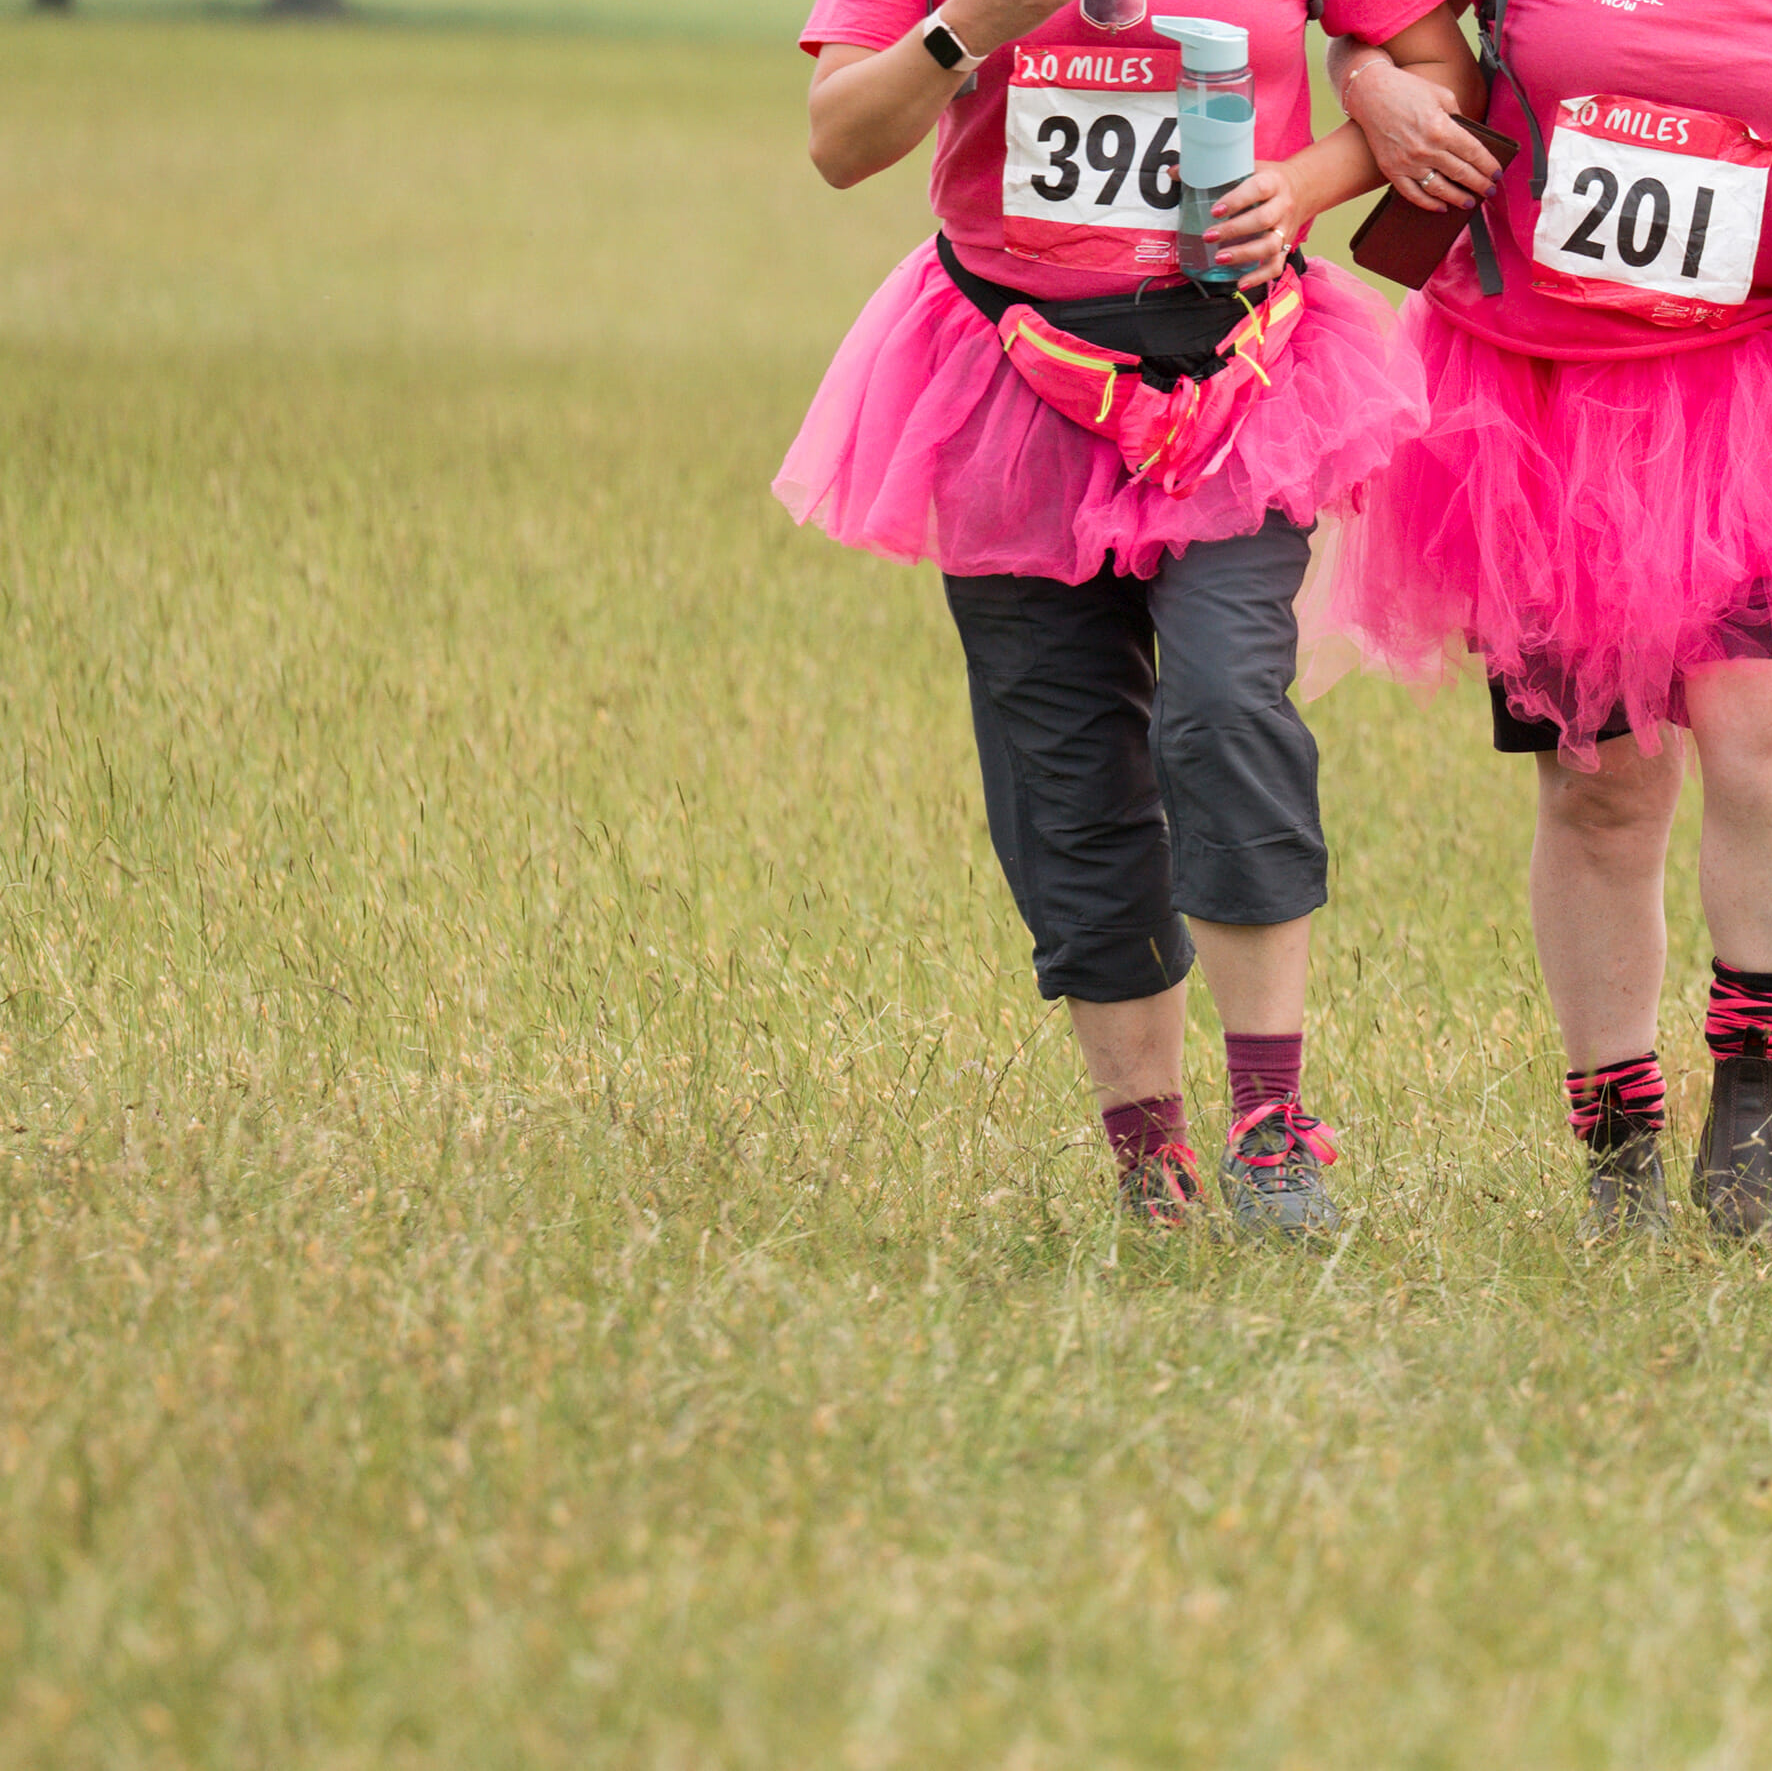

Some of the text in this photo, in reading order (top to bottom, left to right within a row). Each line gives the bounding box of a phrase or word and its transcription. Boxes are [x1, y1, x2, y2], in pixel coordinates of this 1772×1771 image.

[1021, 54, 1154, 84] 20 MILES
[1604, 108, 1690, 145] MILES
[1031, 115, 1182, 210] 396
[1560, 166, 1715, 279] 201
